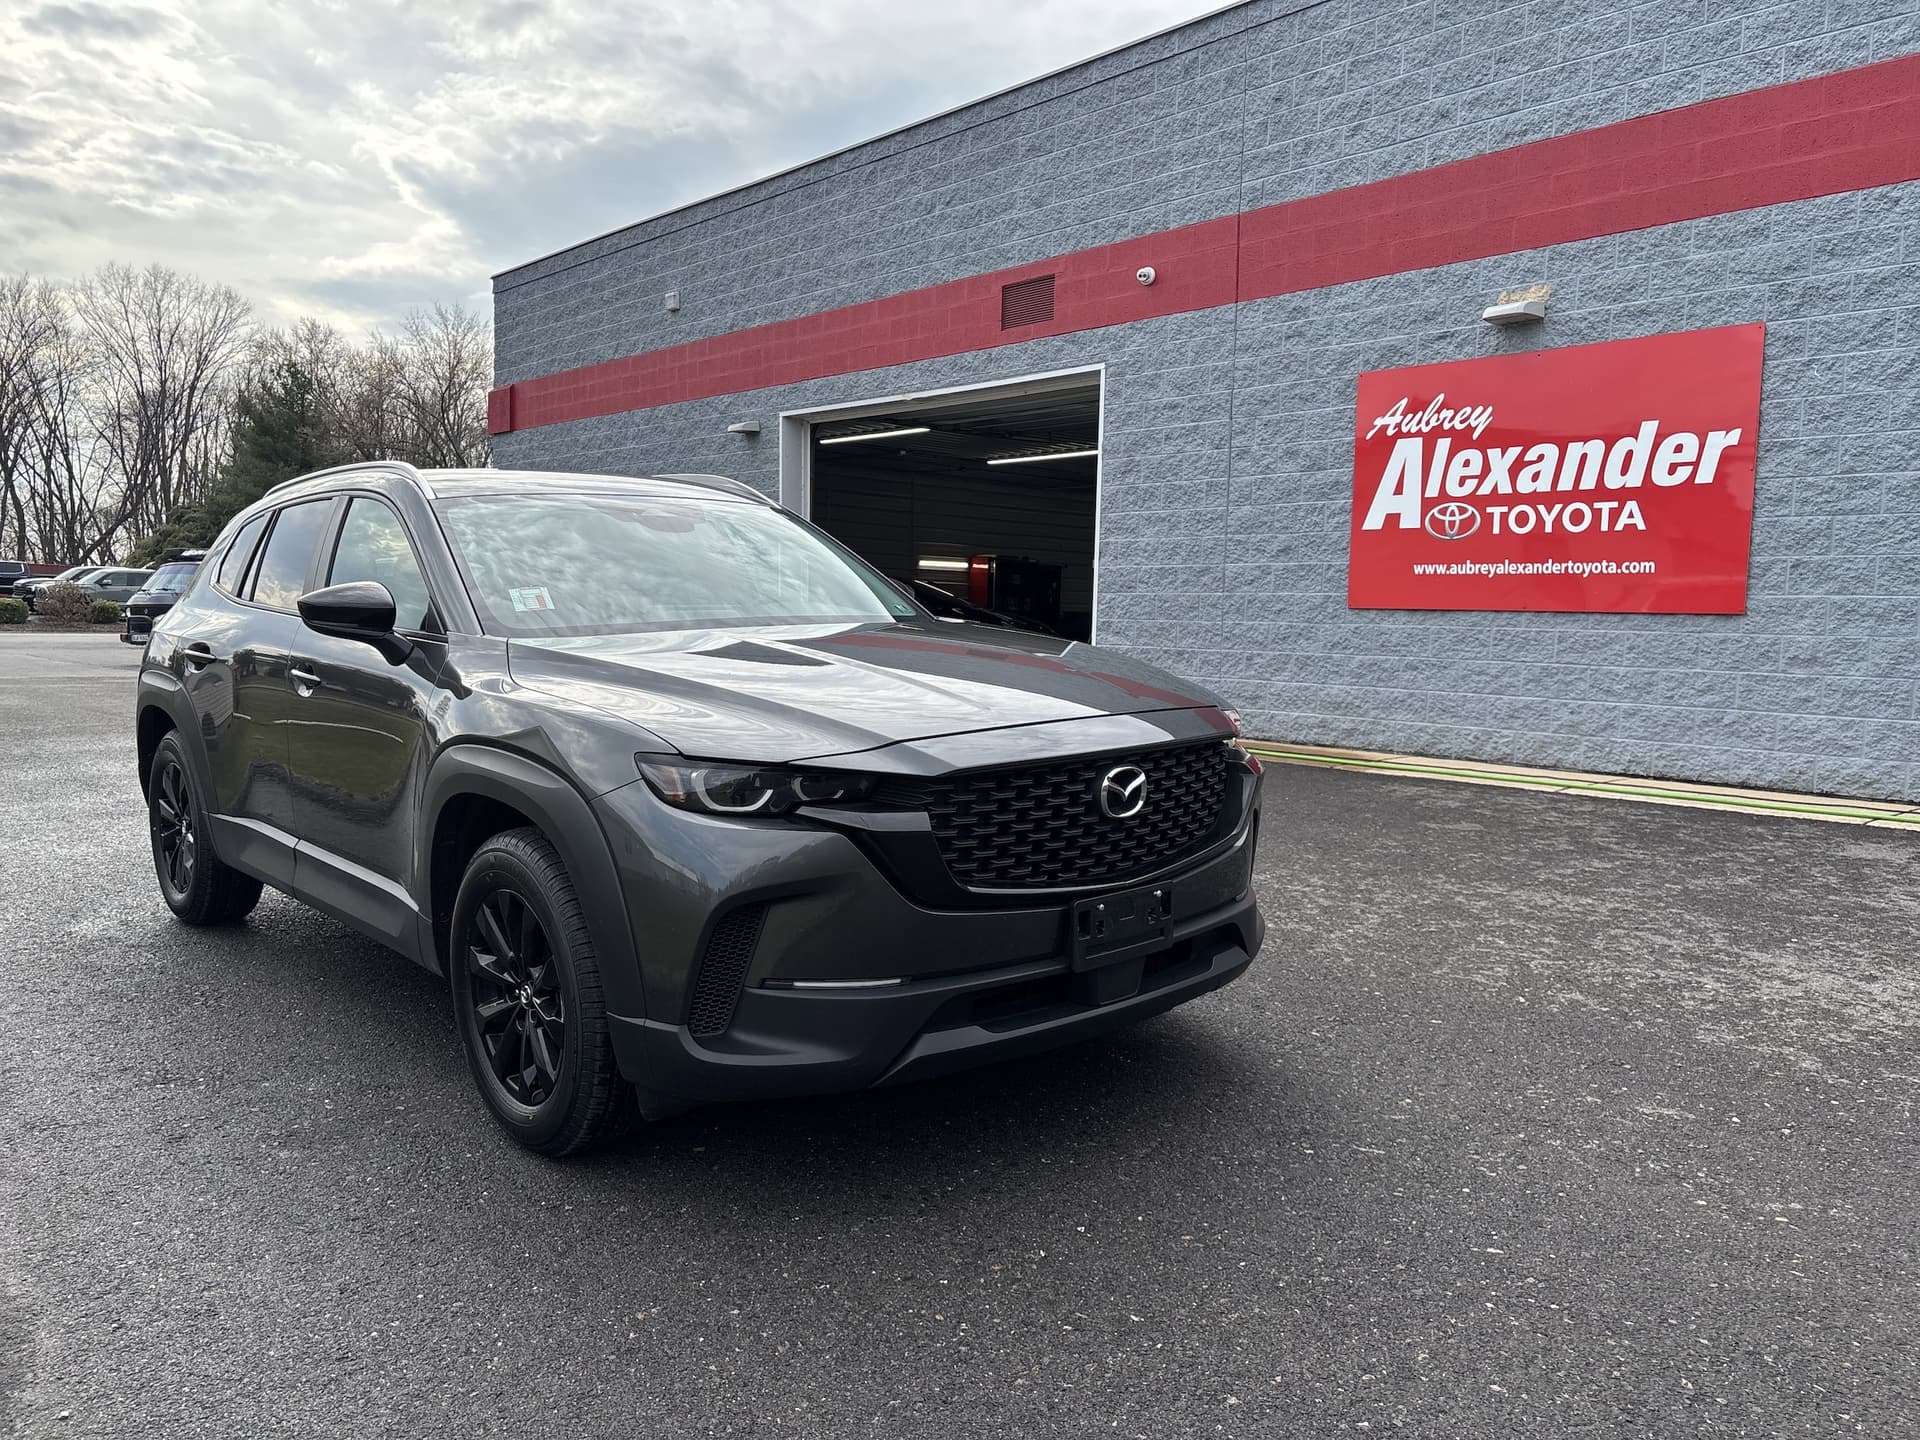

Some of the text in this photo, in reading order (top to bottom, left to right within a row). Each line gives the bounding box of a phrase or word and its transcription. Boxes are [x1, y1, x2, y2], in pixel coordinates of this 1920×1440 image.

[1366, 393, 1493, 440] Aubrey
[1362, 420, 1742, 531] Alexander
[1486, 501, 1647, 535] TOYOTA
[1413, 558, 1656, 578] www.aubreyalexandertoyota.com
